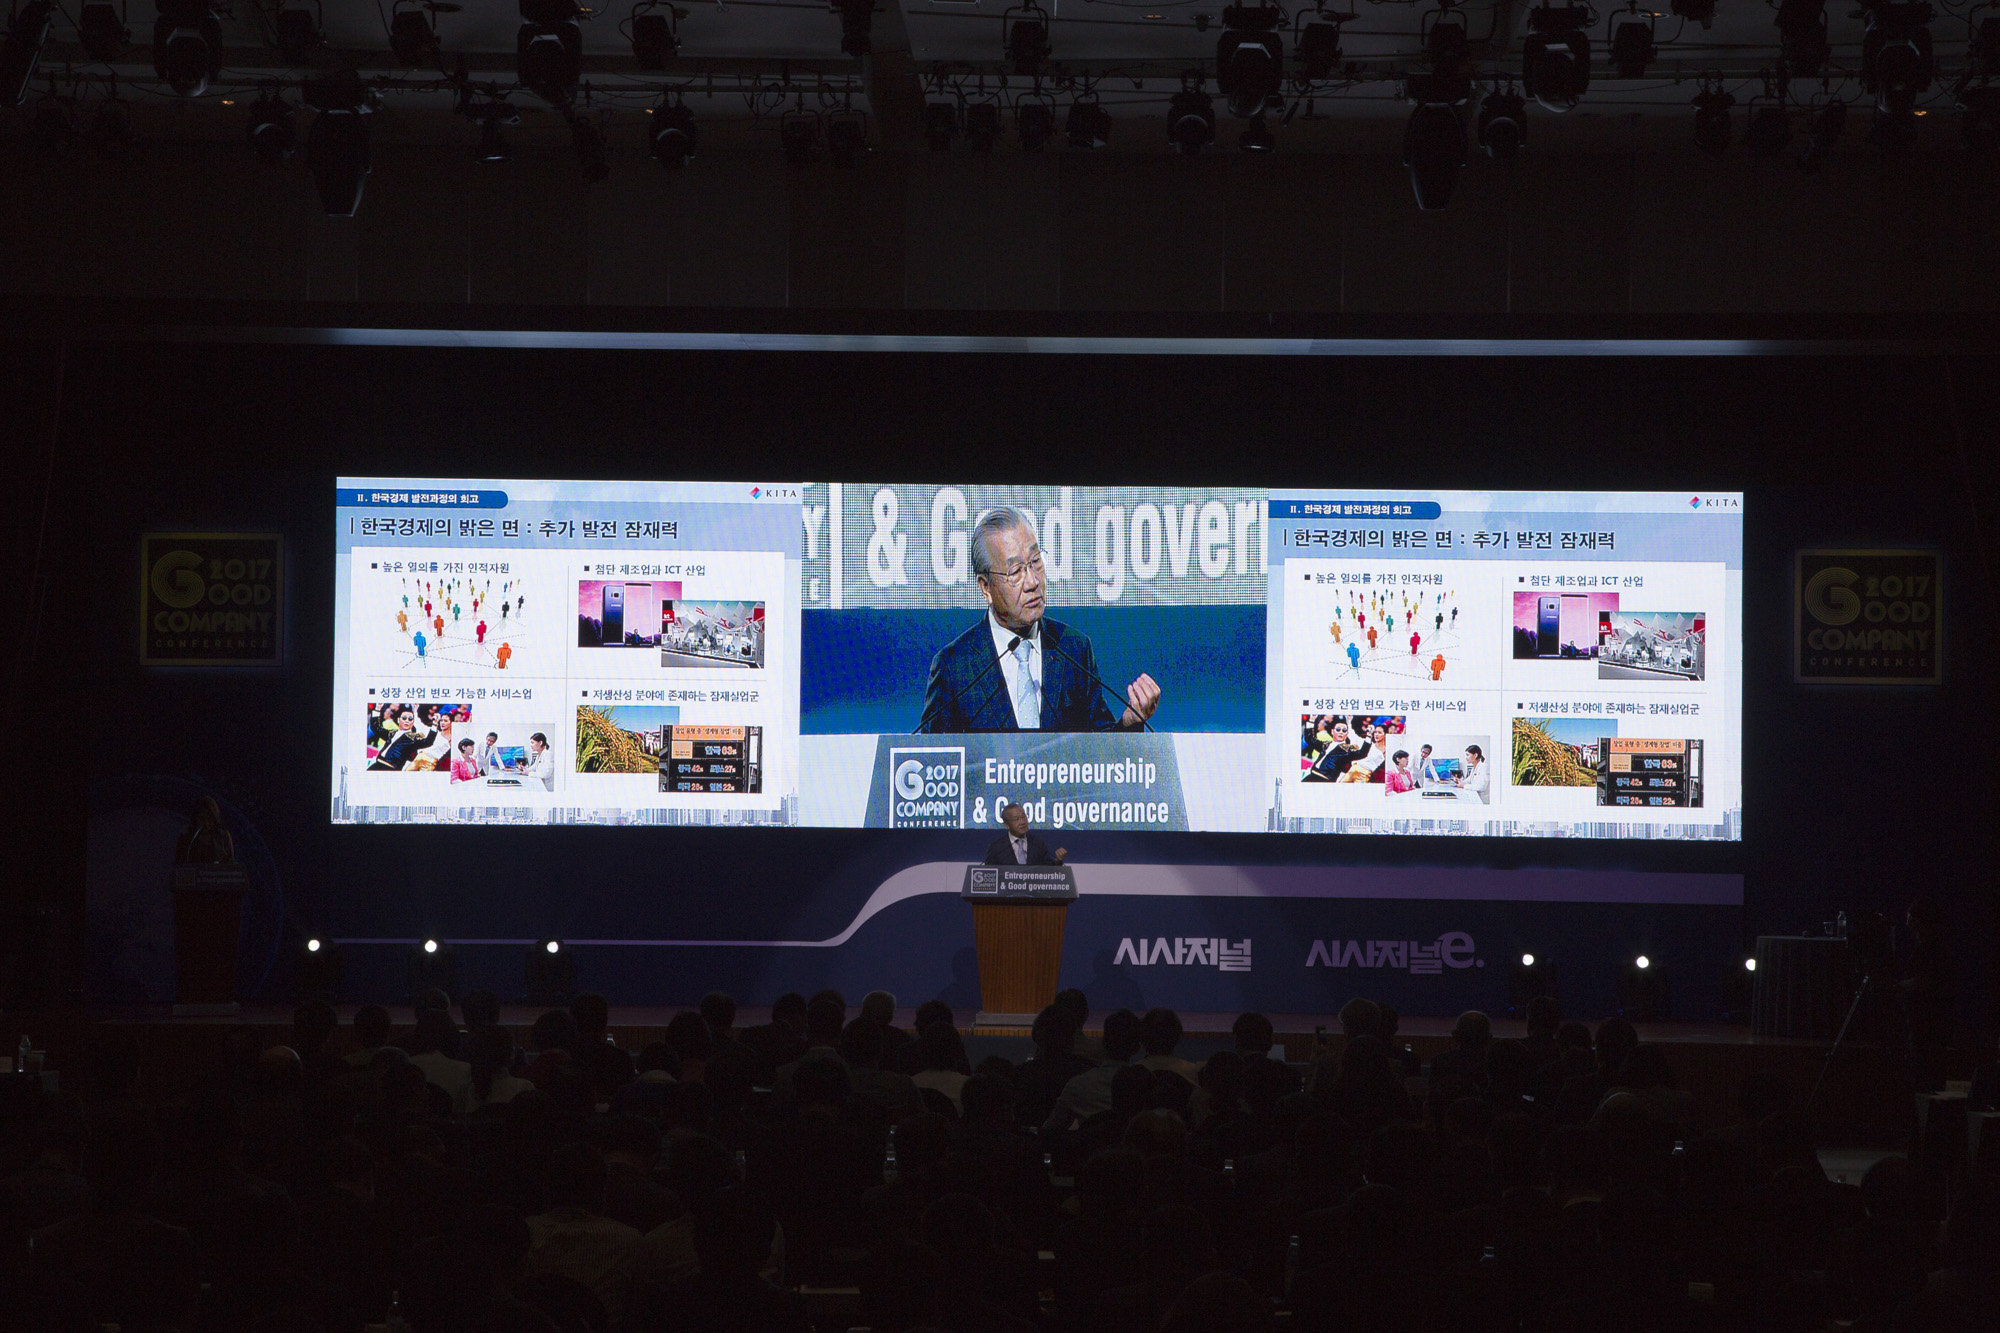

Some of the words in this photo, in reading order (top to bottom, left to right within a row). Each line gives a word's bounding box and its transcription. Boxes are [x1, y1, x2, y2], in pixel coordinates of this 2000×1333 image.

[371, 493, 409, 503] 한국경제
[411, 494, 457, 504] 발전과정의
[460, 494, 479, 504] 회고
[766, 490, 797, 498] KITA
[1706, 499, 1738, 507] KITA
[1304, 505, 1341, 515] 한국경제
[1344, 505, 1390, 515] 발전과정의
[1393, 506, 1412, 516] 회고
[361, 517, 451, 536] 한국경제의
[459, 519, 495, 537] 밝은
[502, 519, 519, 537] 면
[539, 520, 575, 538] 추가
[582, 520, 617, 539] 발전
[624, 521, 678, 539] 잠재력
[931, 486, 1073, 585] Gd
[1096, 500, 1268, 602] gover
[1294, 529, 1384, 547] 한국경제의
[1392, 530, 1428, 548] 밝은
[1435, 530, 1452, 548] 면
[1472, 531, 1509, 549] 추가
[1517, 531, 1552, 549] 발전
[1560, 532, 1614, 550] 잠재력
[209, 558, 272, 580] 2017
[383, 561, 403, 573] 높은
[408, 561, 438, 573] 열의를
[443, 562, 464, 573] 가진
[468, 562, 510, 574] 인적자원
[595, 564, 615, 575] 첨단
[619, 564, 661, 576] 제조업과
[665, 565, 681, 575] ICT
[685, 565, 706, 576] 산업
[1316, 573, 1336, 584] 높은
[1341, 573, 1371, 584] 열의를
[1376, 573, 1397, 585] 가진
[1401, 574, 1443, 585] 인적자원
[1530, 575, 1550, 586] 첨단
[1555, 576, 1598, 587] 제조업과
[1602, 577, 1618, 586] ICT
[1623, 576, 1643, 587] 산업
[1865, 575, 1930, 598] 2017
[154, 610, 273, 633] COMPANY
[155, 639, 268, 648] CONFERENCE
[1808, 628, 1931, 651] COMPANY
[1810, 657, 1928, 667] CONFERENCE
[381, 687, 401, 698] 성장
[405, 687, 426, 698] 산업
[430, 688, 451, 698] 변모
[455, 688, 486, 699] 가능한
[491, 688, 532, 699] 서비스업
[593, 689, 632, 701] 저생산성
[635, 690, 665, 701] 분야에
[668, 690, 707, 702] 존재하는
[710, 691, 759, 702] 잠재실업군
[1314, 699, 1335, 710] 성장
[1339, 699, 1359, 710] 산업
[1364, 699, 1385, 710] 변모
[1389, 700, 1420, 711] 가능한
[1425, 700, 1467, 712] 서비스업
[1529, 701, 1569, 713] 저생산성
[1572, 702, 1601, 713] 분야에
[1605, 702, 1645, 714] 존재하는
[1649, 703, 1700, 715] 잠재실업군
[925, 765, 959, 780] 2017
[986, 757, 1156, 789] Entrepreneurship
[896, 801, 959, 817] COMPANY
[972, 797, 987, 823] &
[995, 796, 1046, 823] God
[1053, 802, 1169, 828] governance
[897, 820, 957, 828] CONFERENCE
[1004, 871, 1066, 881] Entrepreneurship
[1000, 882, 1006, 890] &
[1008, 882, 1026, 890] Good
[1029, 883, 1070, 892] governance
[1113, 937, 1251, 972] 시사저널
